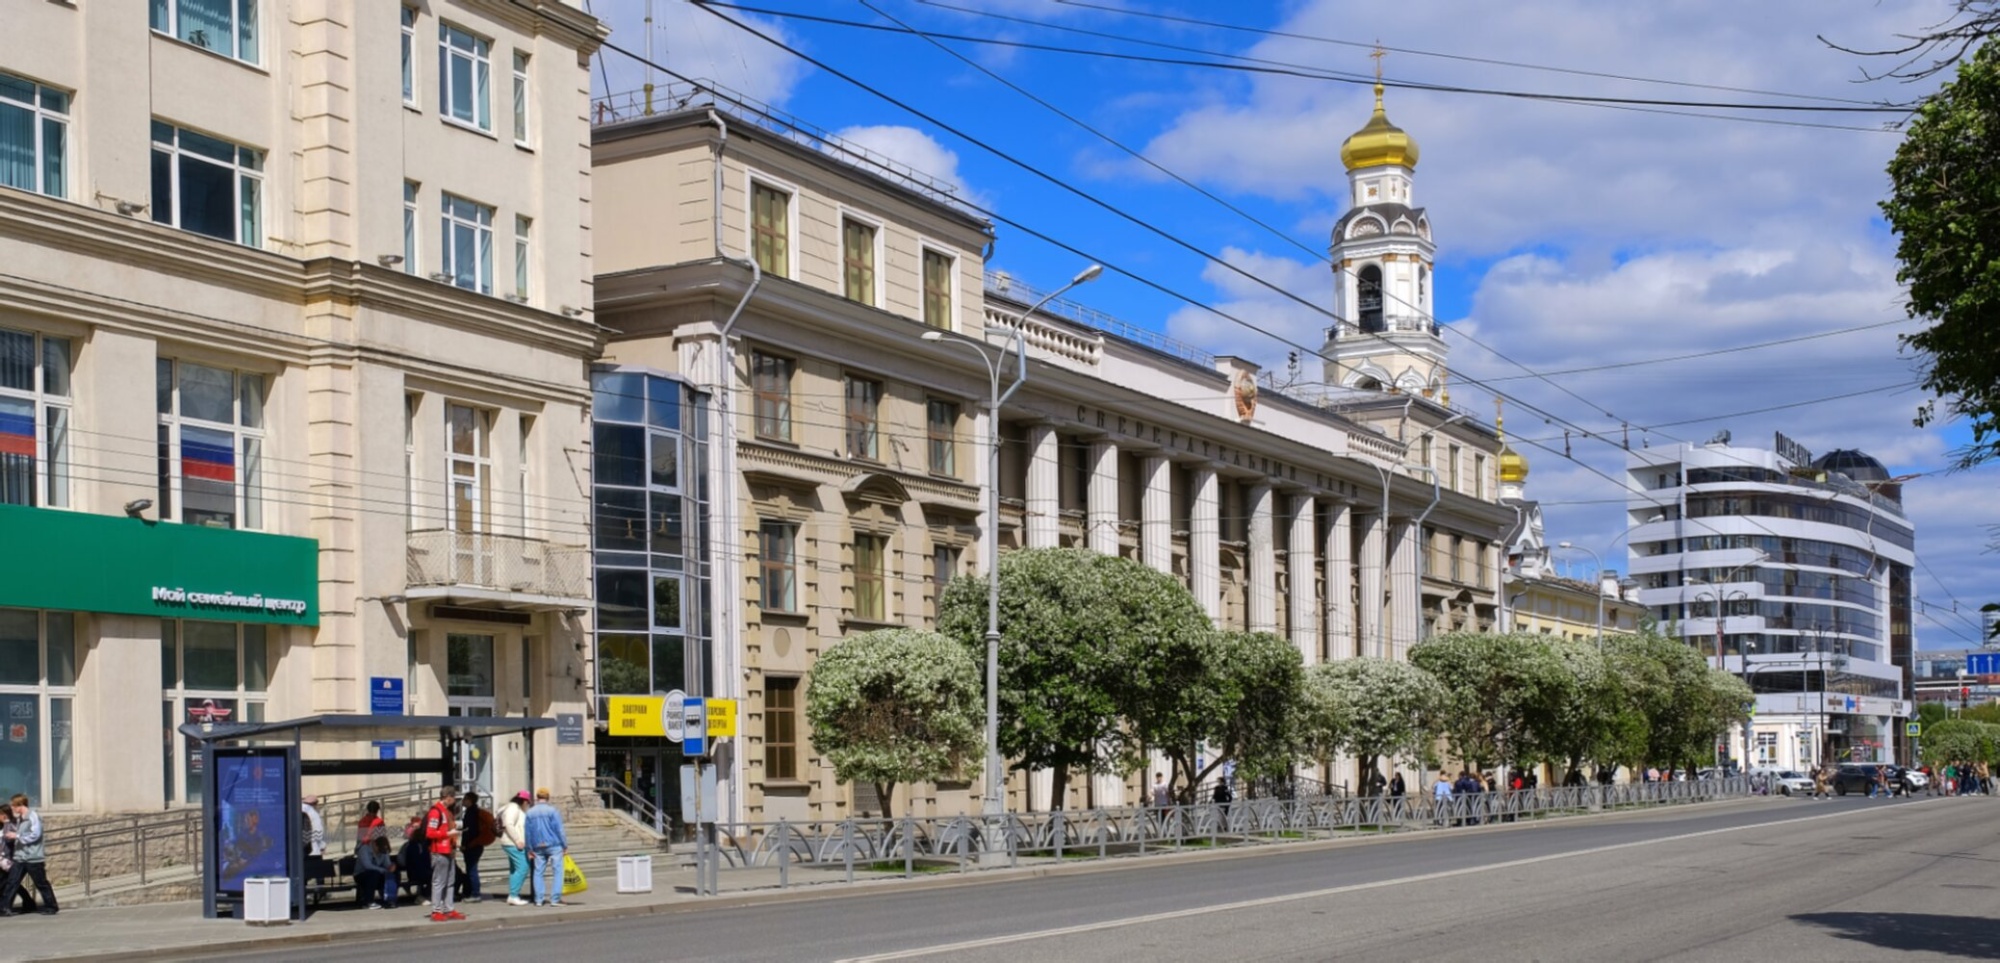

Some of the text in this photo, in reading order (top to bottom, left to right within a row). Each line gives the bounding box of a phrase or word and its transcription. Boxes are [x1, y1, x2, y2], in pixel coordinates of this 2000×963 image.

[152, 586, 307, 614] Мой семейный центр
[622, 718, 636, 728] КОФЕ
